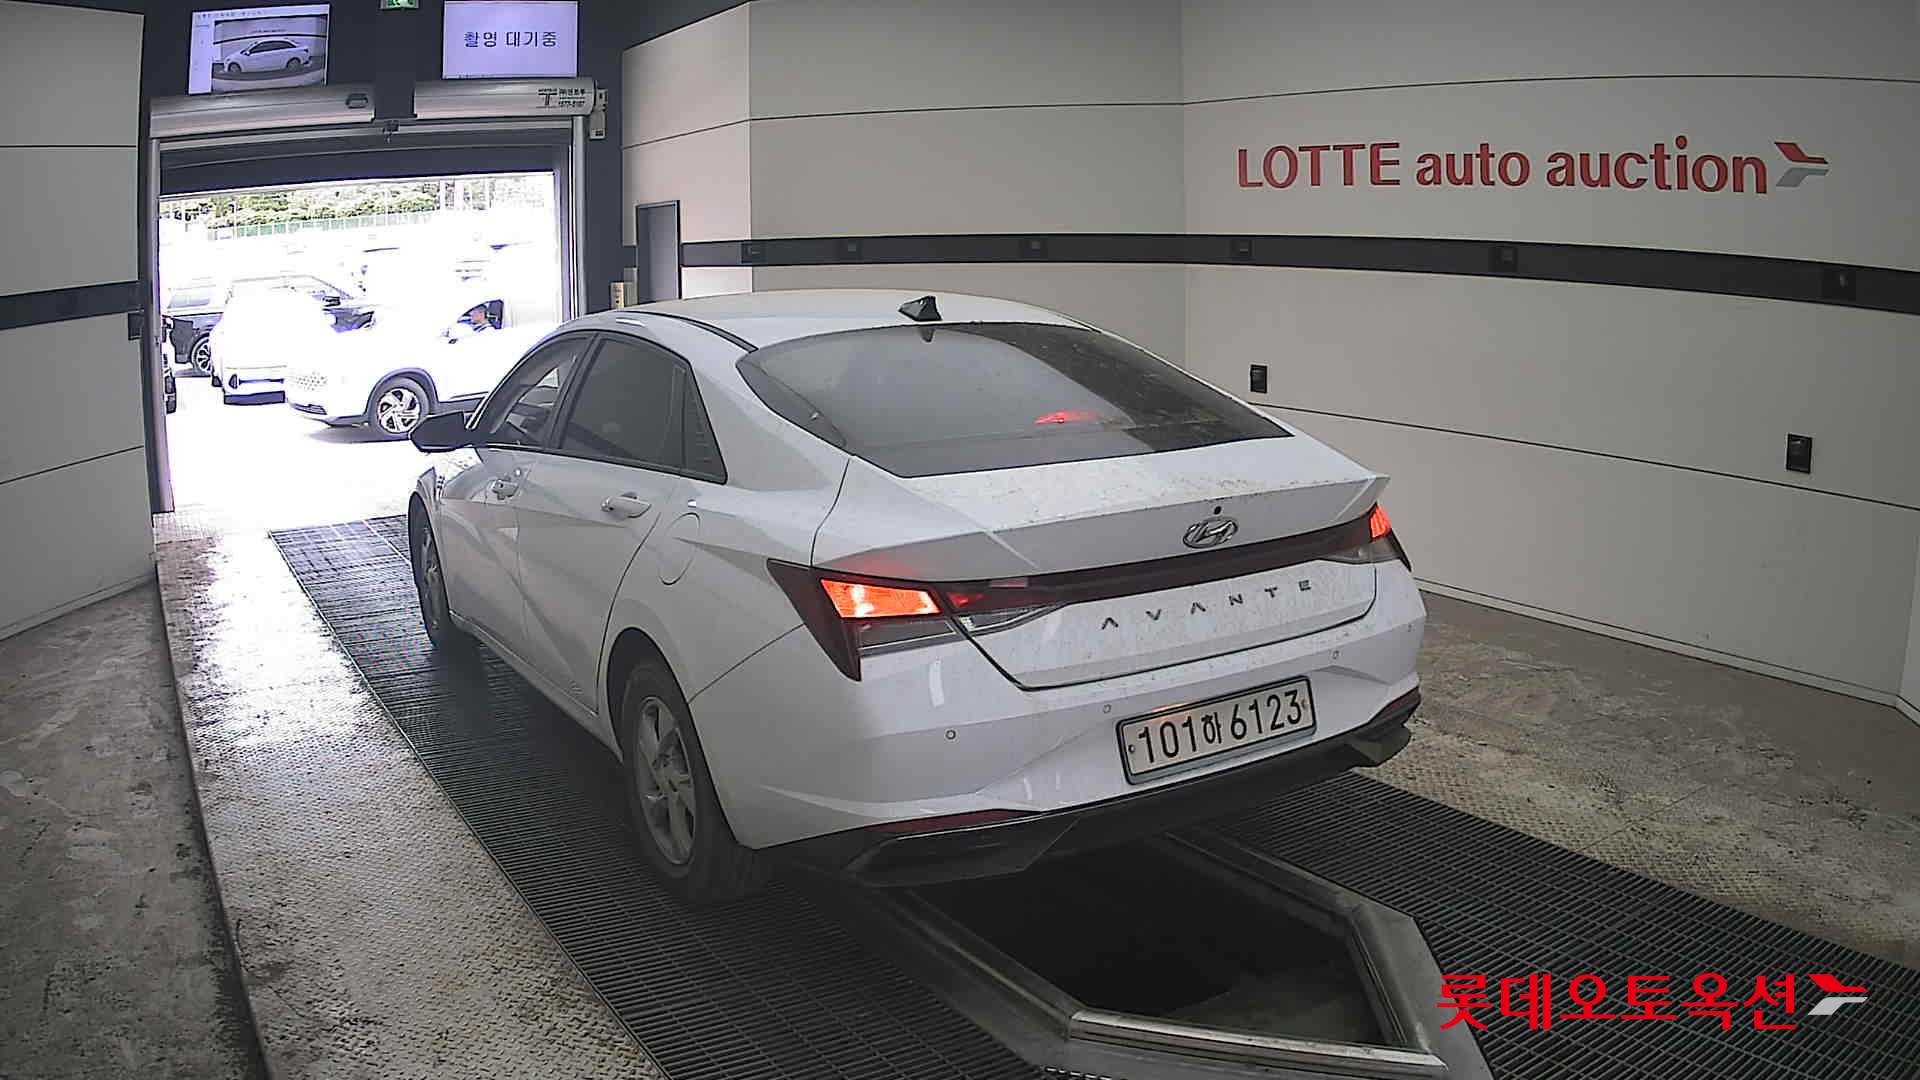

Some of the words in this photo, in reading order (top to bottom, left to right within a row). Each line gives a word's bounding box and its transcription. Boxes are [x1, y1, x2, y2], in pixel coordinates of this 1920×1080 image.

[506, 31, 557, 48] 대기중
[1238, 142, 1400, 188] LOTTE
[1416, 142, 1530, 187] auto
[1546, 135, 1768, 194] auction
[1101, 579, 1312, 630] AVANTE
[1138, 689, 1302, 763] 101하6123
